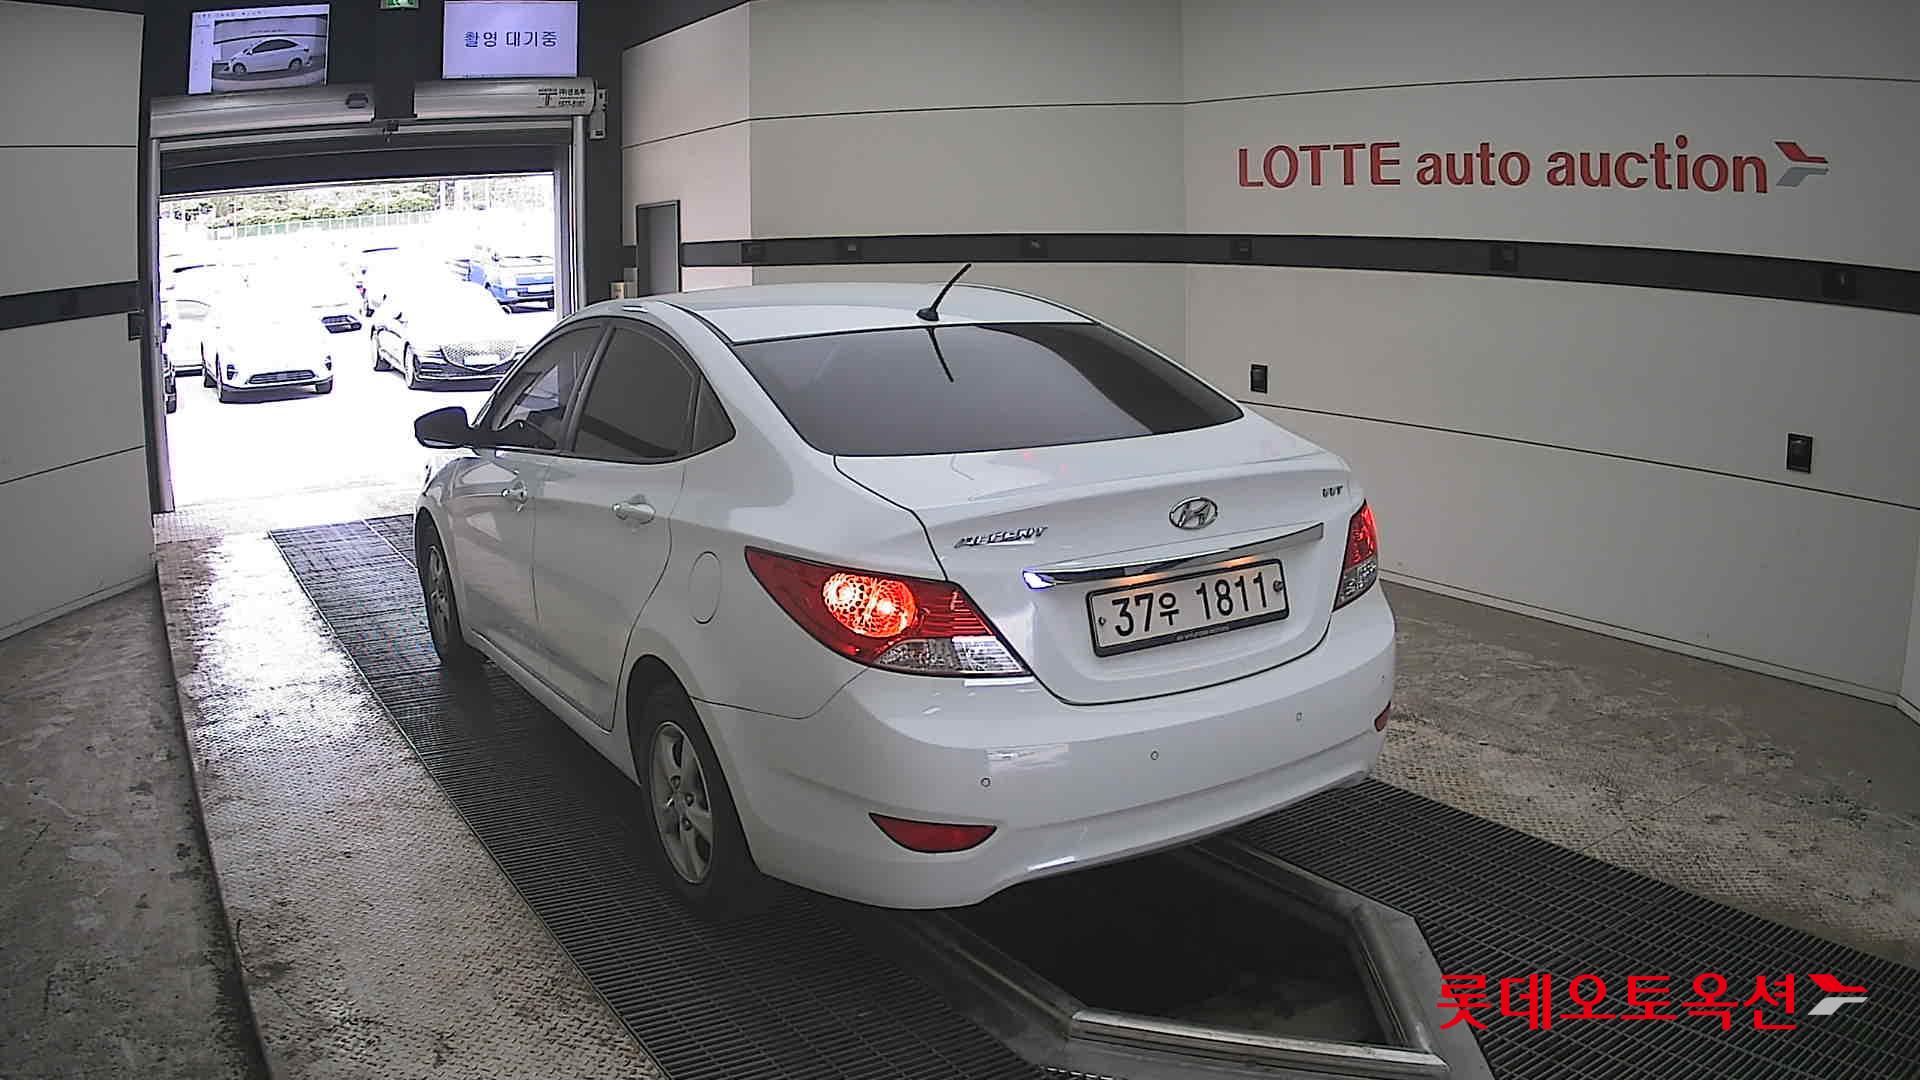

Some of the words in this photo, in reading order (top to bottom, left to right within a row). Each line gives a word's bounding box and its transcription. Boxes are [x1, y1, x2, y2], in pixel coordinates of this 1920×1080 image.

[505, 31, 557, 48] 대기중
[1238, 142, 1400, 189] LOTTE
[1416, 142, 1531, 186] auto
[1546, 134, 1768, 193] auction
[1111, 592, 1180, 637] 37우
[1195, 571, 1268, 620] 1811
